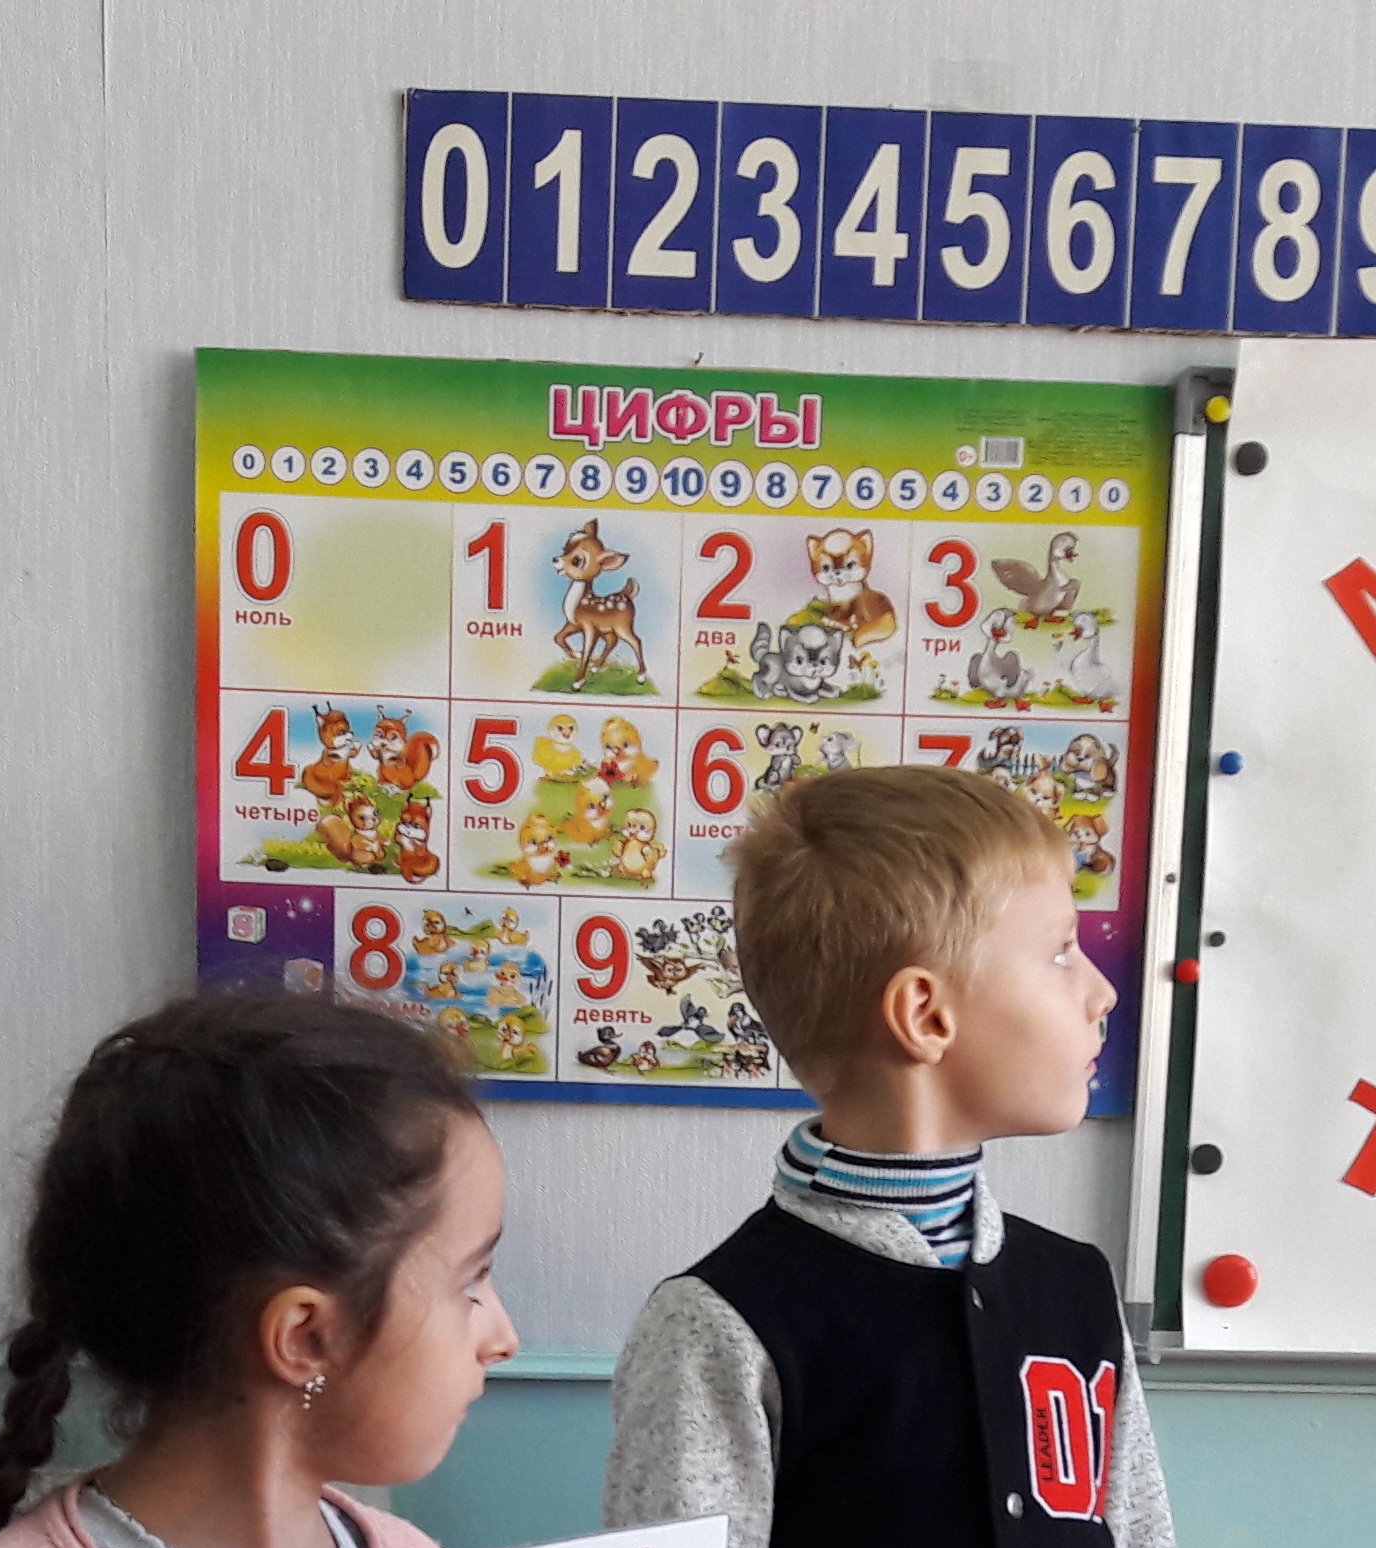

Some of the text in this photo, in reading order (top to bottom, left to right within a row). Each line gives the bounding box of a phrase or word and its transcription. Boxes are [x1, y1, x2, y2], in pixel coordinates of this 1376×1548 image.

[422, 124, 490, 267] 0
[533, 130, 581, 272] 1
[627, 135, 700, 277] 2
[731, 138, 803, 281] 3
[834, 144, 910, 286] 4
[940, 148, 1012, 289] 5
[1046, 151, 1117, 293] 6
[1152, 156, 1223, 295] 7
[1250, 159, 1321, 301] 8
[554, 389, 816, 447] ЦИФРЫ
[243, 454, 1119, 502] 0 1 2 3 4 5 6 7 8 9 10 9 8 7 6 5 4 3 2 1 0
[235, 511, 291, 602] 0
[467, 522, 505, 610] 1
[696, 532, 752, 619] 2
[925, 540, 979, 628] 3
[235, 609, 292, 626] ноль
[467, 620, 523, 637] один
[695, 628, 737, 651] два
[922, 636, 962, 656] три
[235, 710, 296, 796] 4
[465, 718, 520, 804] 5
[692, 728, 745, 815] 6
[235, 806, 319, 826] четыре
[464, 814, 516, 831] пять
[350, 905, 403, 991] 8
[575, 915, 629, 999] 9
[573, 1005, 653, 1028] девять
